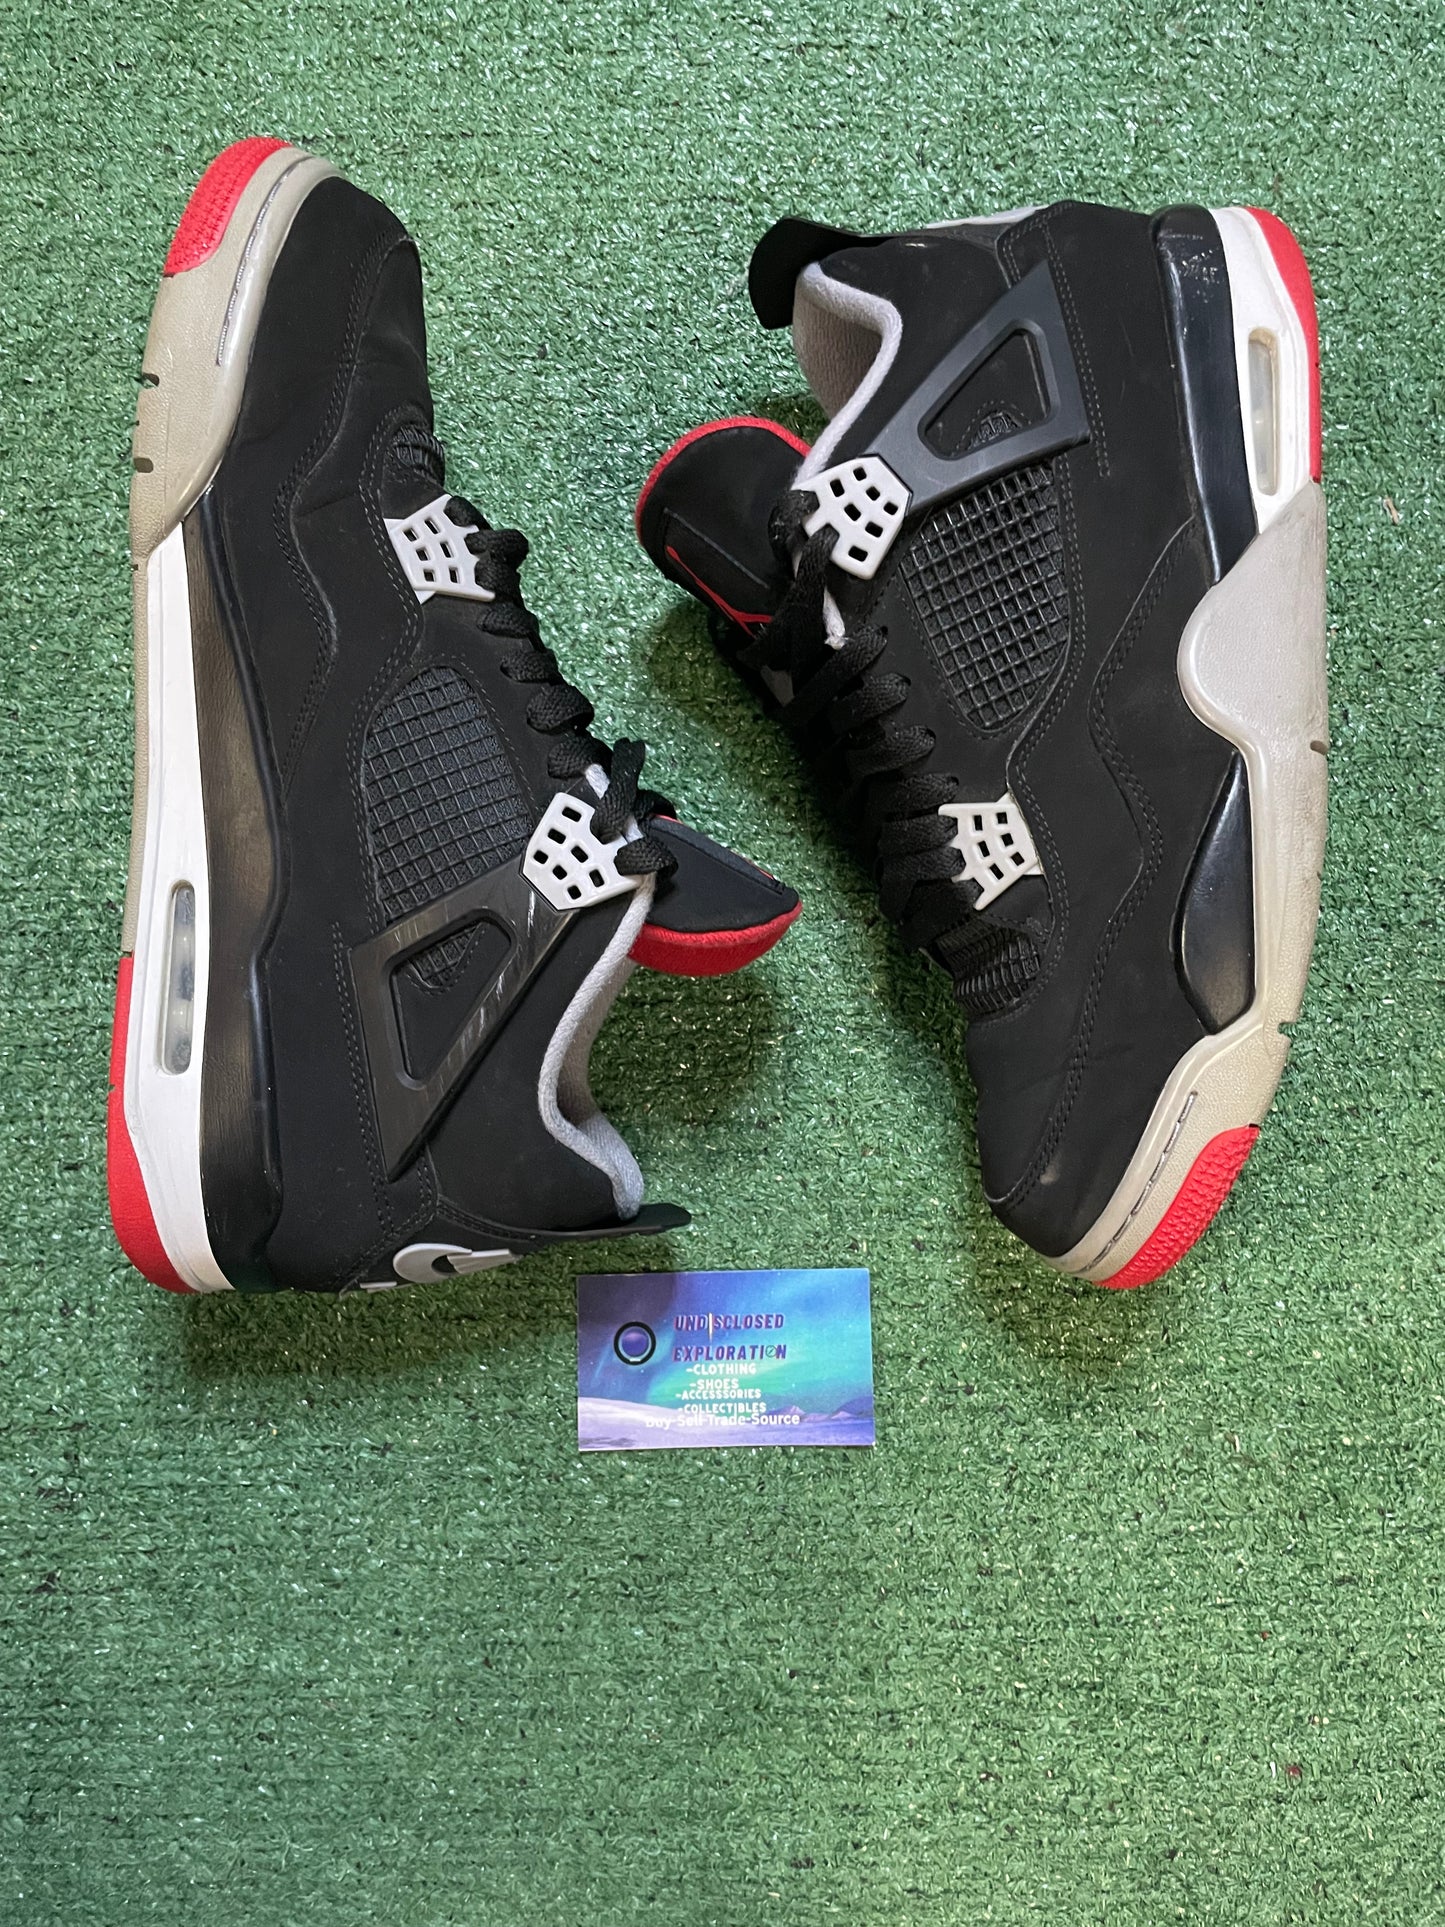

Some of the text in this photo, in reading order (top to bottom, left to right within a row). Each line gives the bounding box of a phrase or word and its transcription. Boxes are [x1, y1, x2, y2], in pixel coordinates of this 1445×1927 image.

[673, 1344, 787, 1362] EXPLORATION
[686, 1363, 757, 1375] -CLOTHING
[689, 1379, 739, 1390] -SHOES
